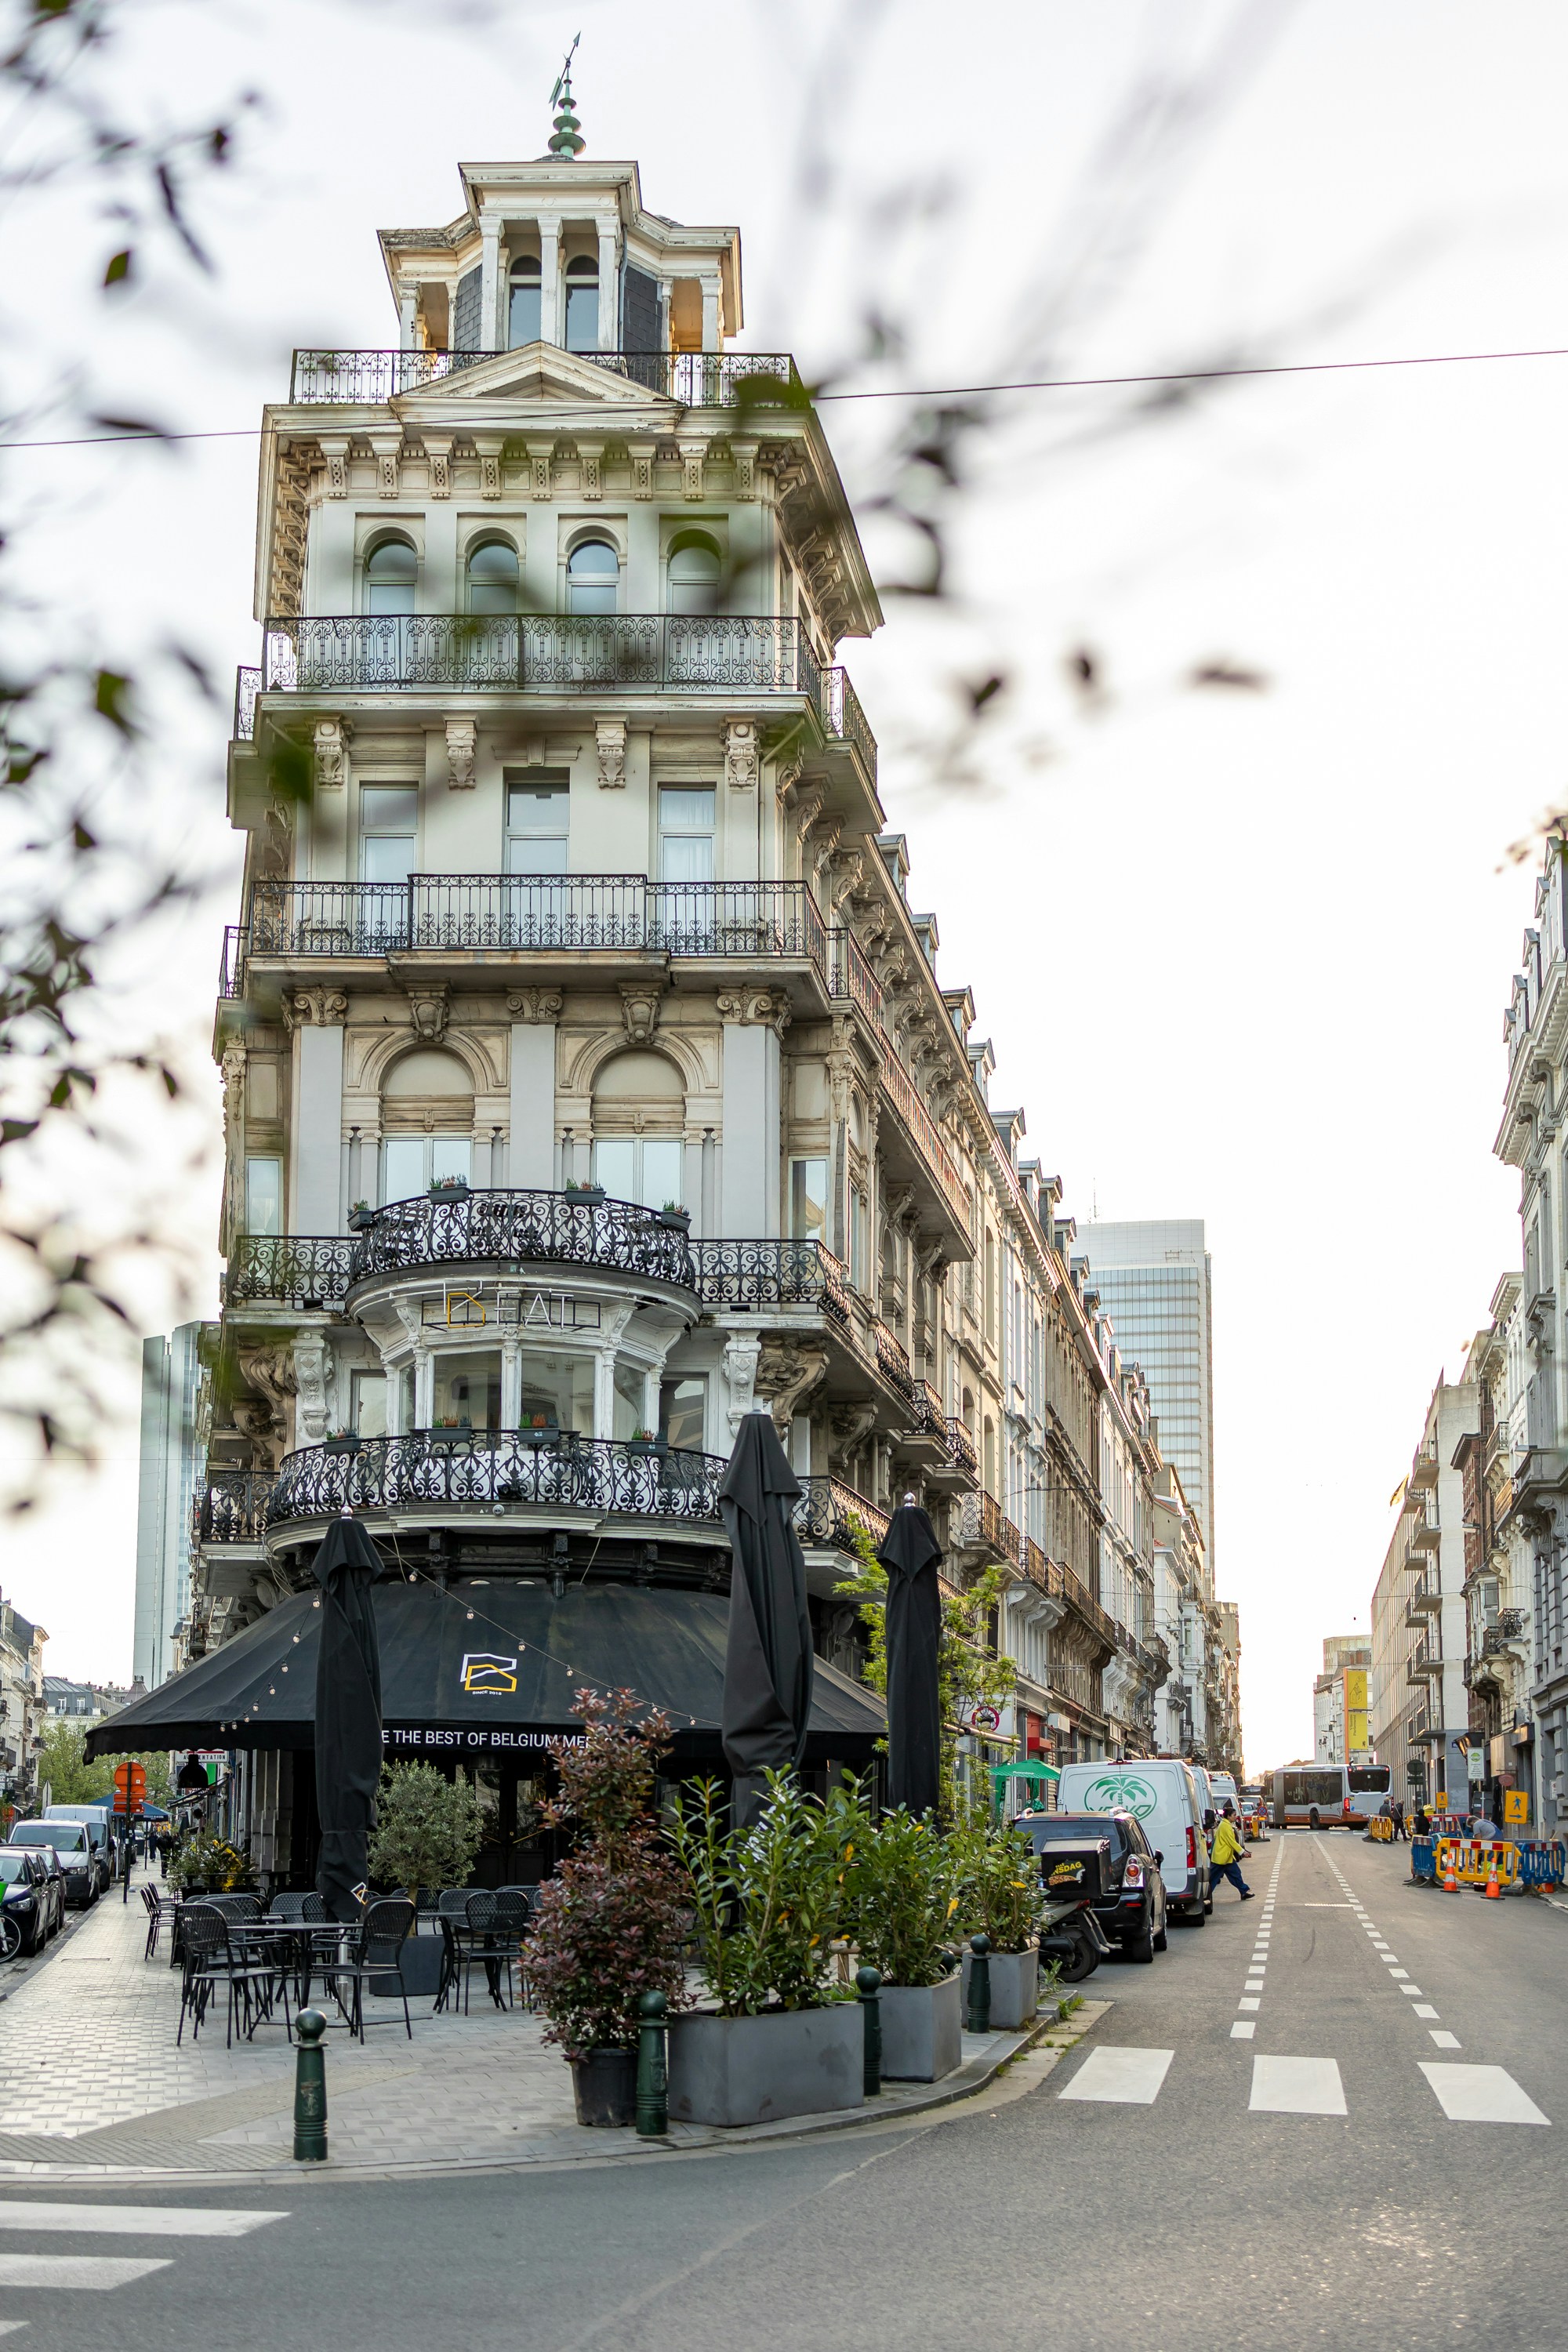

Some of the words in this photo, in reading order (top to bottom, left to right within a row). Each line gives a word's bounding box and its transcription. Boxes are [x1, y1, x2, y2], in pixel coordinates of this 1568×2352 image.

[393, 1730, 422, 1744] THE
[426, 1730, 464, 1745] BEST
[467, 1732, 488, 1746] OF
[491, 1732, 559, 1748] BELGIUM
